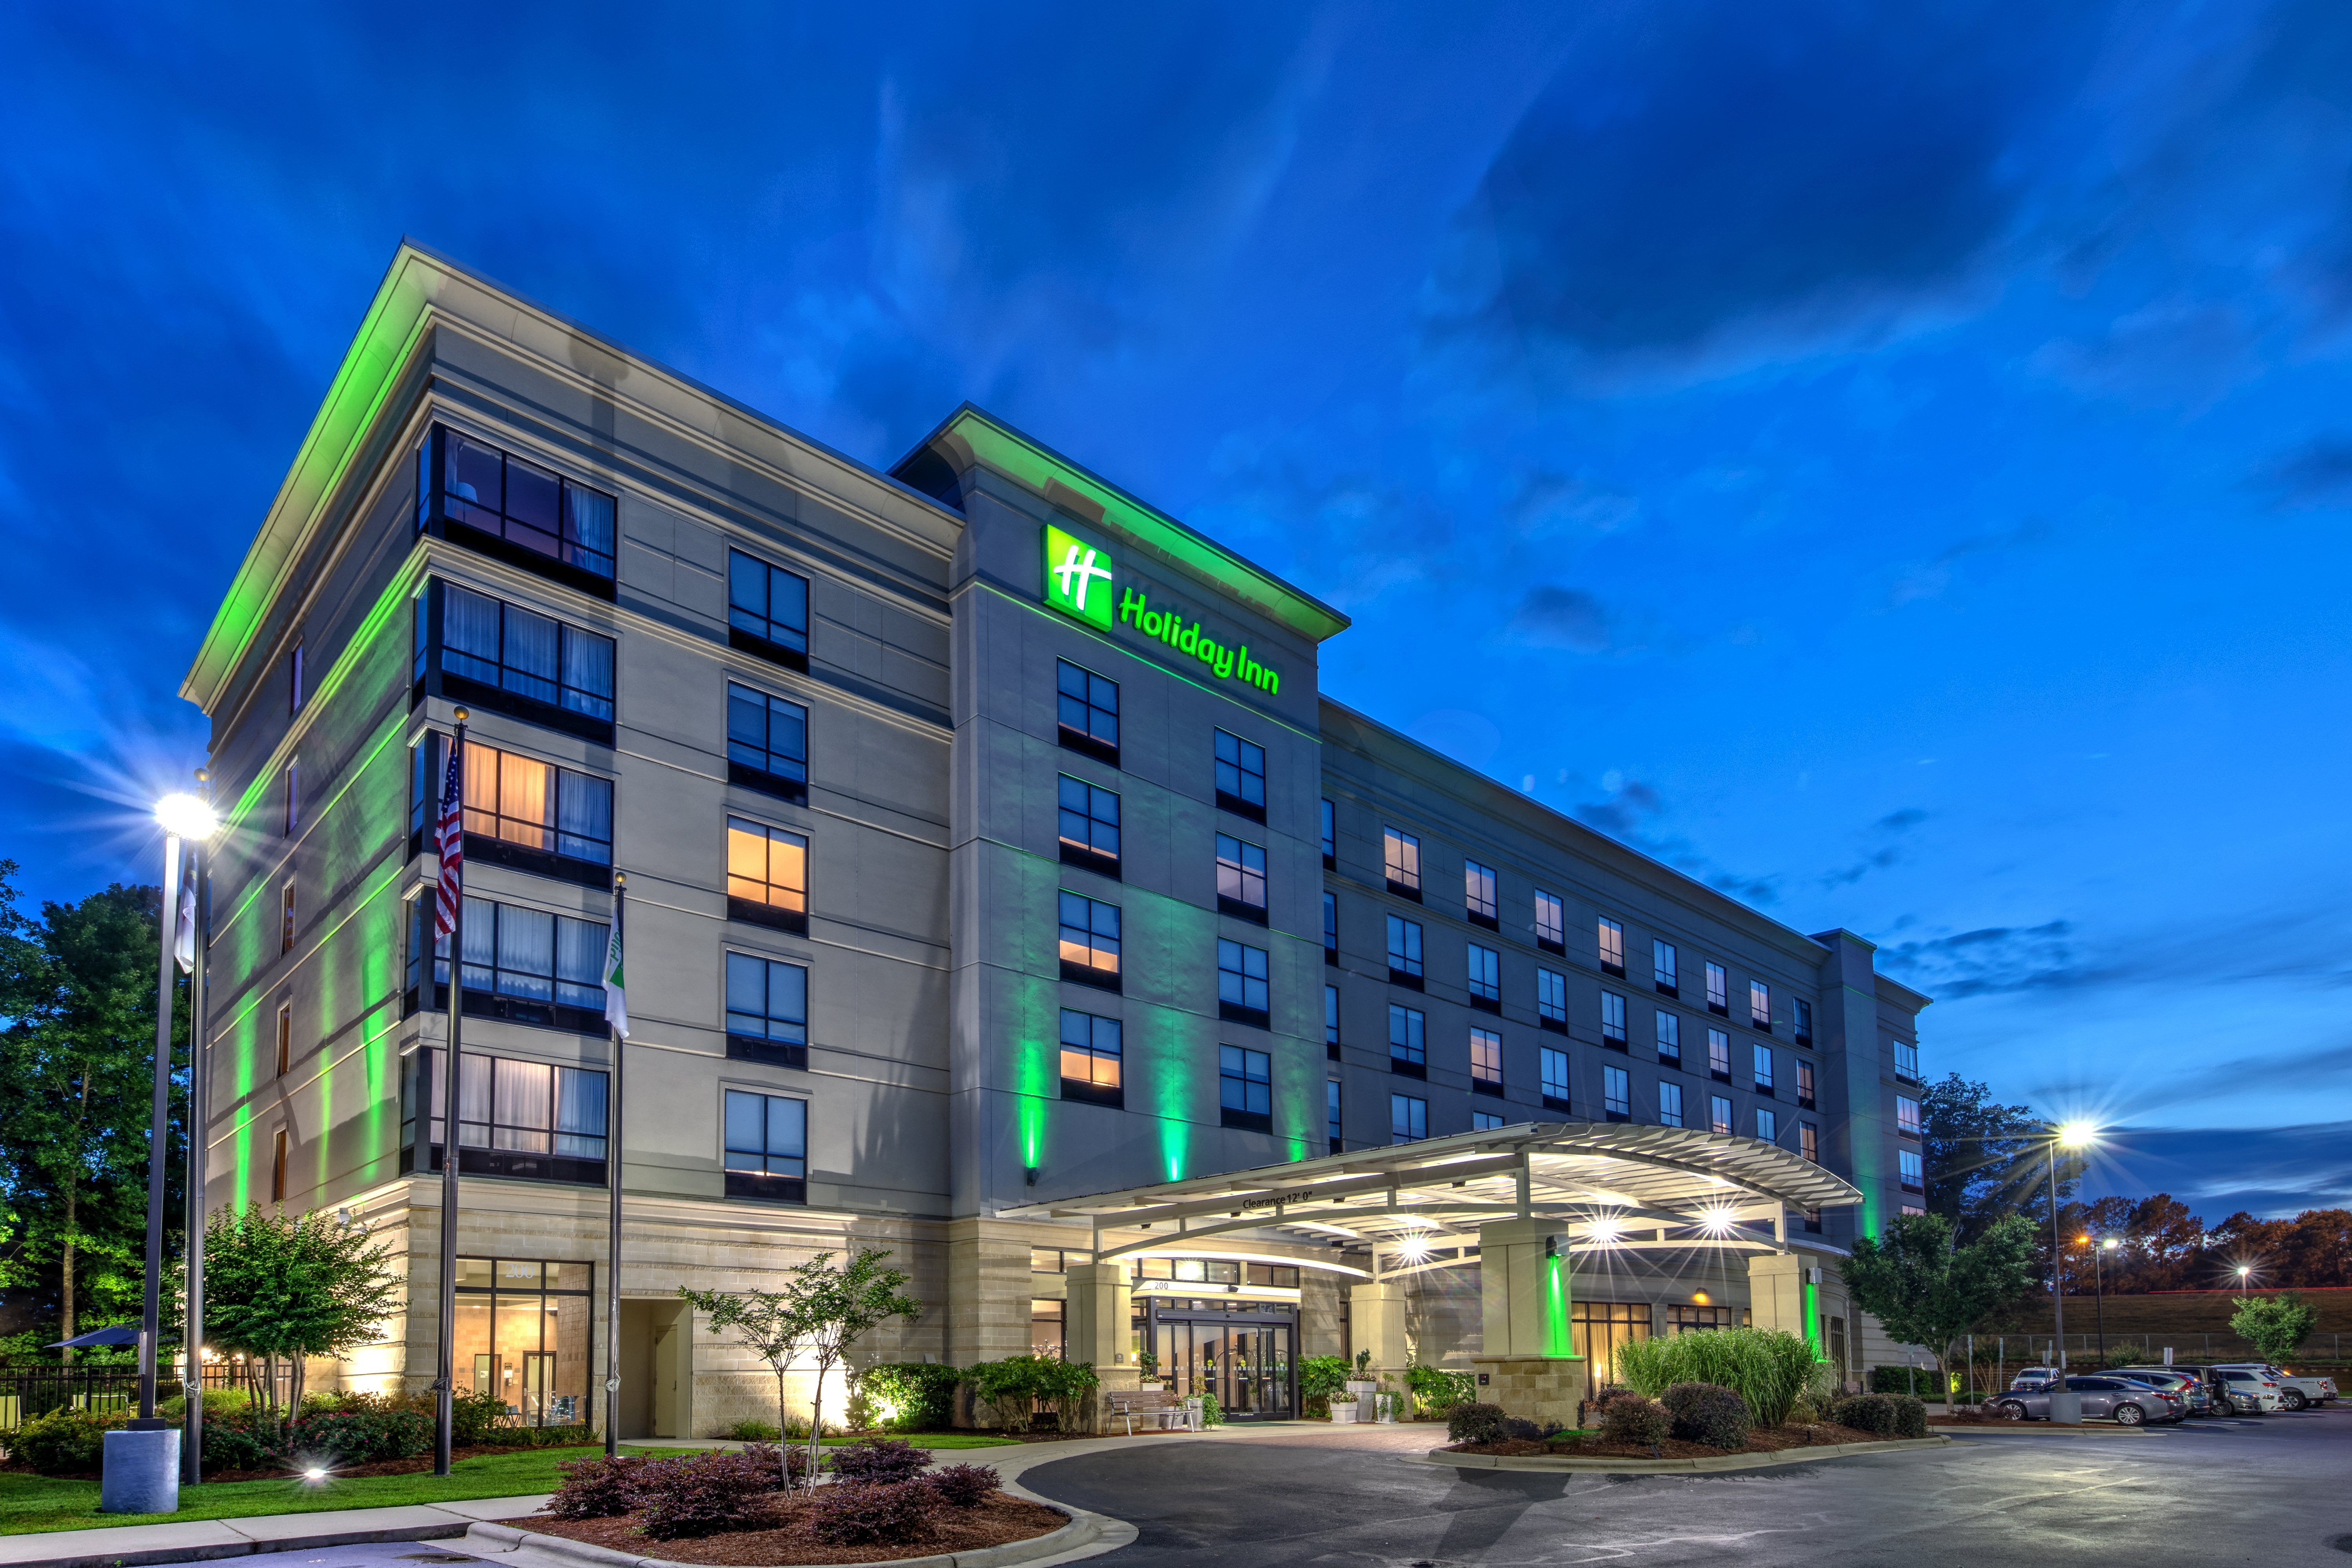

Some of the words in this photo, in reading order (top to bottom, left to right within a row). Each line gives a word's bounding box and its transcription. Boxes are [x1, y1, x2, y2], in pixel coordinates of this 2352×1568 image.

[1118, 586, 1234, 679] Holiday
[1237, 645, 1279, 696] Inn
[1243, 1196, 1286, 1209] Clearance
[1287, 1192, 1300, 1203] 12'
[505, 1263, 535, 1278] 200
